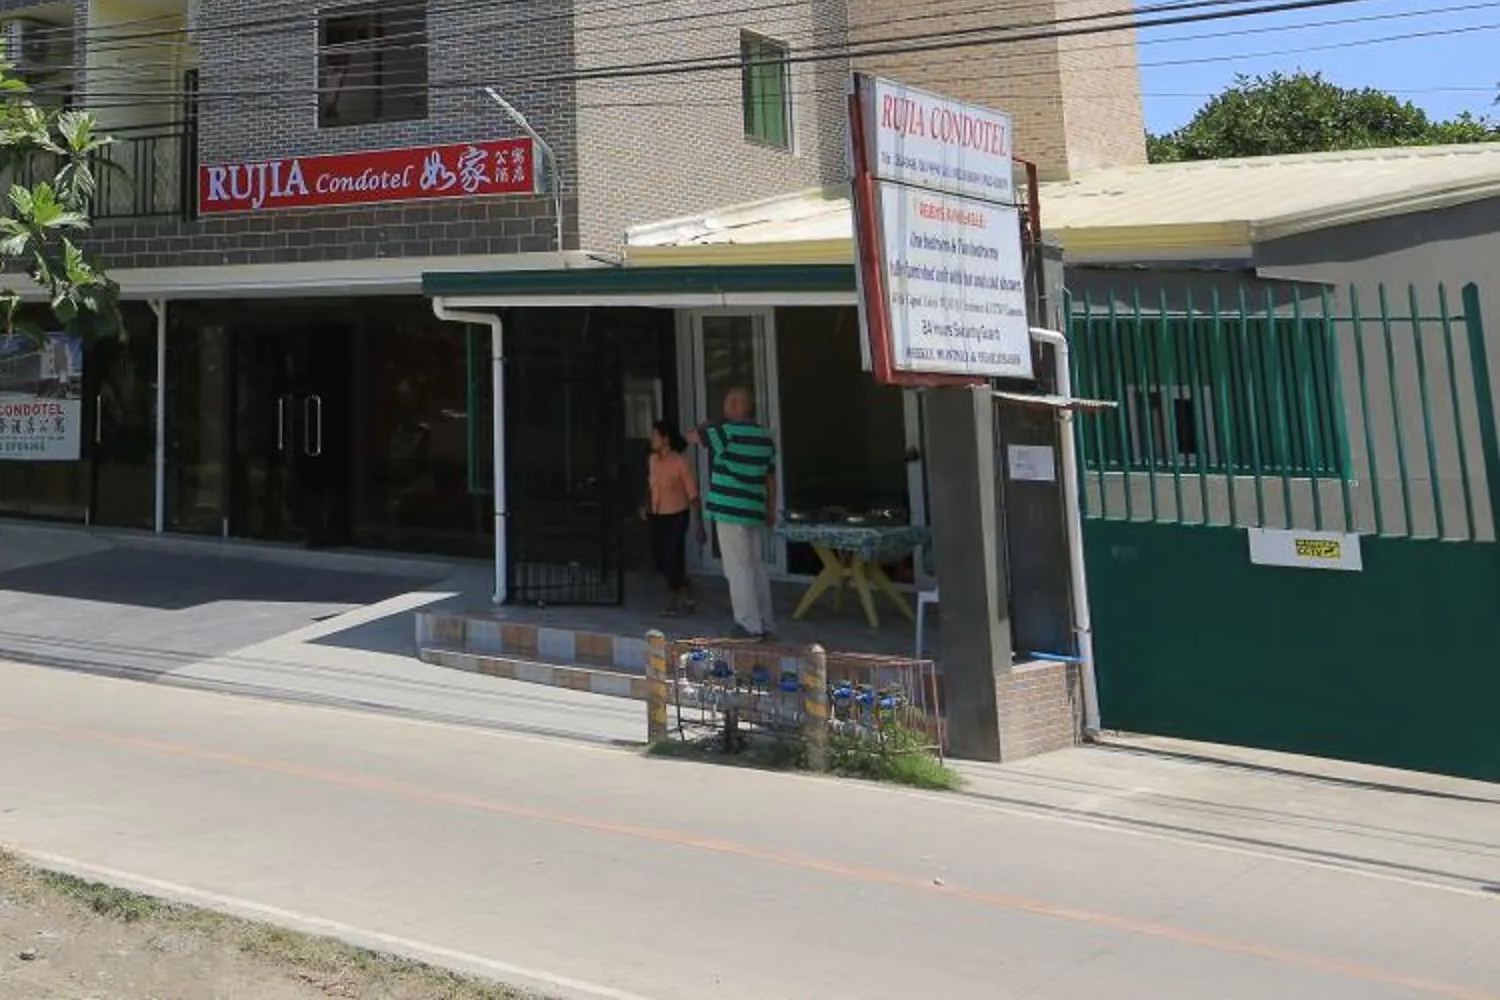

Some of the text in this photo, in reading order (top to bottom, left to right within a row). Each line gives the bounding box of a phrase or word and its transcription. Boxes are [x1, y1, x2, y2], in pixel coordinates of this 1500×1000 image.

[882, 94, 1008, 157] RUJIA CONDOTEL
[207, 160, 412, 209] RUJIA Condotel
[420, 146, 491, 193] 如家
